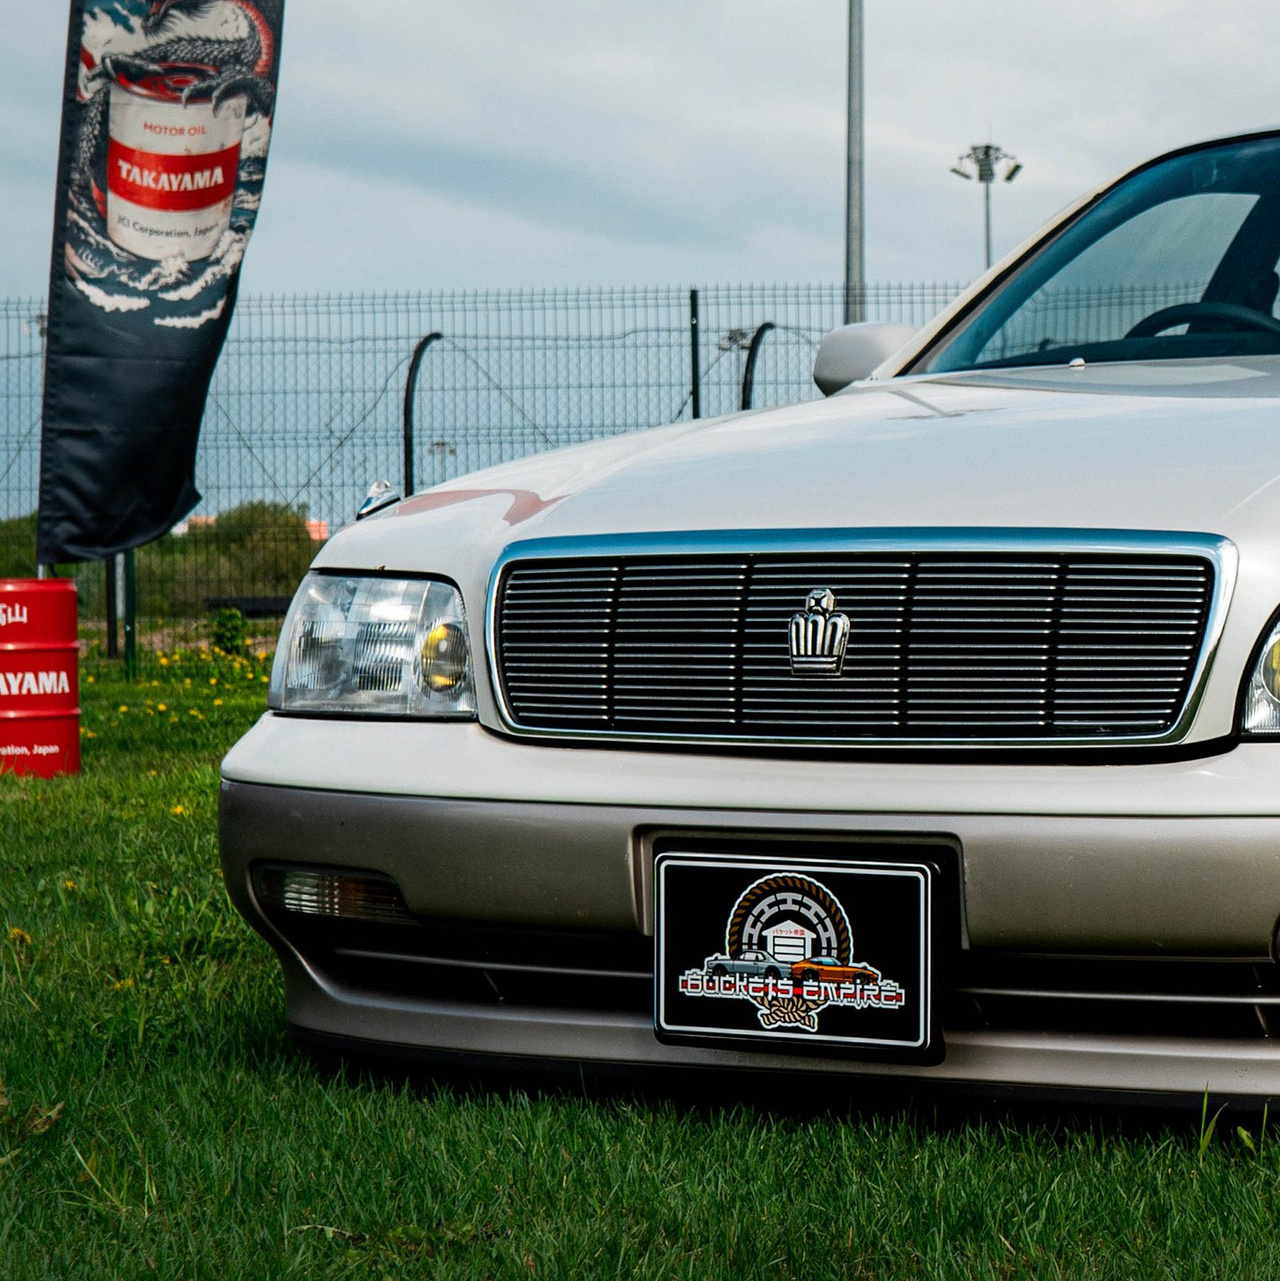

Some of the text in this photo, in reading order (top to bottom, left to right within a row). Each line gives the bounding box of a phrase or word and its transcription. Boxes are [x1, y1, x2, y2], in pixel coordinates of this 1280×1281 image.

[143, 121, 207, 136] MOTOR OIL
[117, 158, 224, 192] TAKAYAMA
[32, 743, 60, 757] Japan
